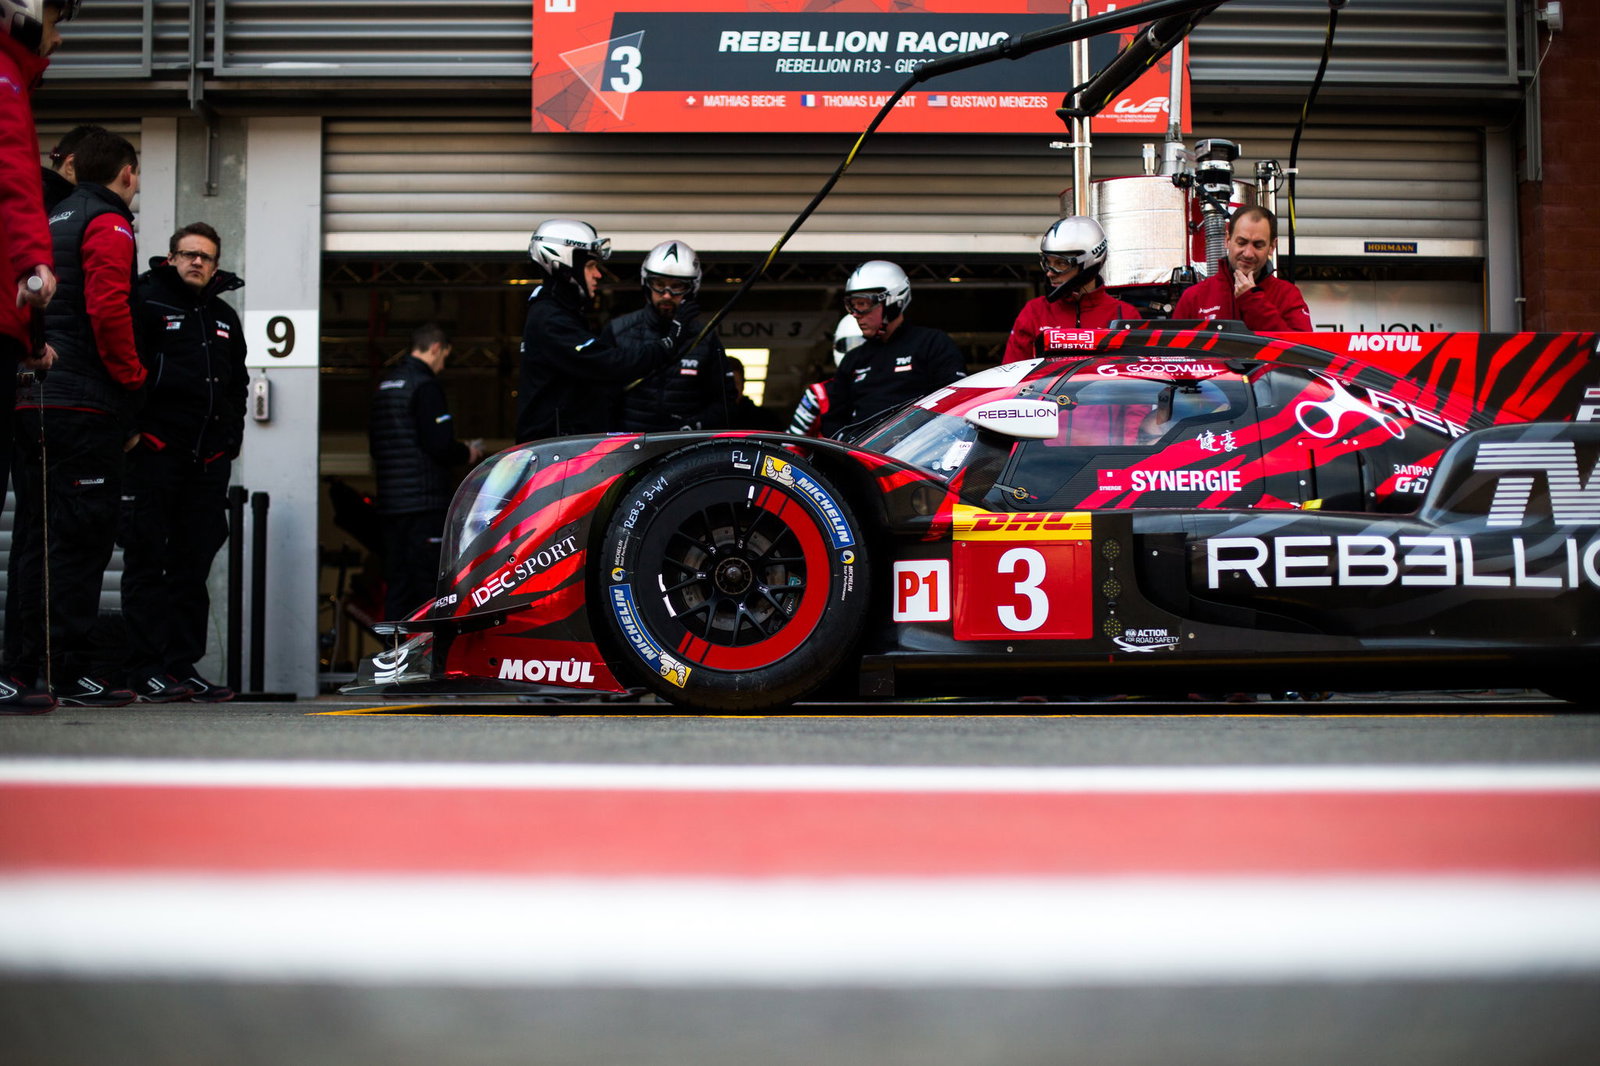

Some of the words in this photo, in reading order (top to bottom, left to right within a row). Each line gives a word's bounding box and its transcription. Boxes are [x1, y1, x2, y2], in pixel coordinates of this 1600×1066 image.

[718, 30, 889, 53] REBELLION
[609, 45, 643, 94] 3
[775, 58, 851, 74] REBELLION
[853, 58, 882, 74] R13
[703, 94, 749, 108] MATHIAS
[751, 94, 786, 108] BECHE
[822, 94, 867, 108] THOMAS
[869, 94, 917, 108] LAUENT
[950, 95, 997, 108] GUSTAVO
[999, 95, 1048, 109] MENEZES
[565, 238, 588, 249] uvex
[266, 315, 296, 359] 9
[1348, 334, 1422, 352] MOTUL
[1126, 364, 1216, 374] GOODWILL
[731, 450, 749, 463] FL
[1131, 469, 1242, 493] SYNERGIE
[624, 508, 640, 529] REB
[796, 477, 850, 543] MICHELIN
[970, 511, 1075, 532] DHL
[471, 570, 516, 608] IDEC
[514, 535, 578, 581] SPORT
[897, 570, 939, 614] P1
[996, 547, 1050, 633] 3
[614, 589, 658, 662] MICHELIN
[1137, 629, 1168, 637] ACTION
[498, 659, 595, 683] MOTUL
